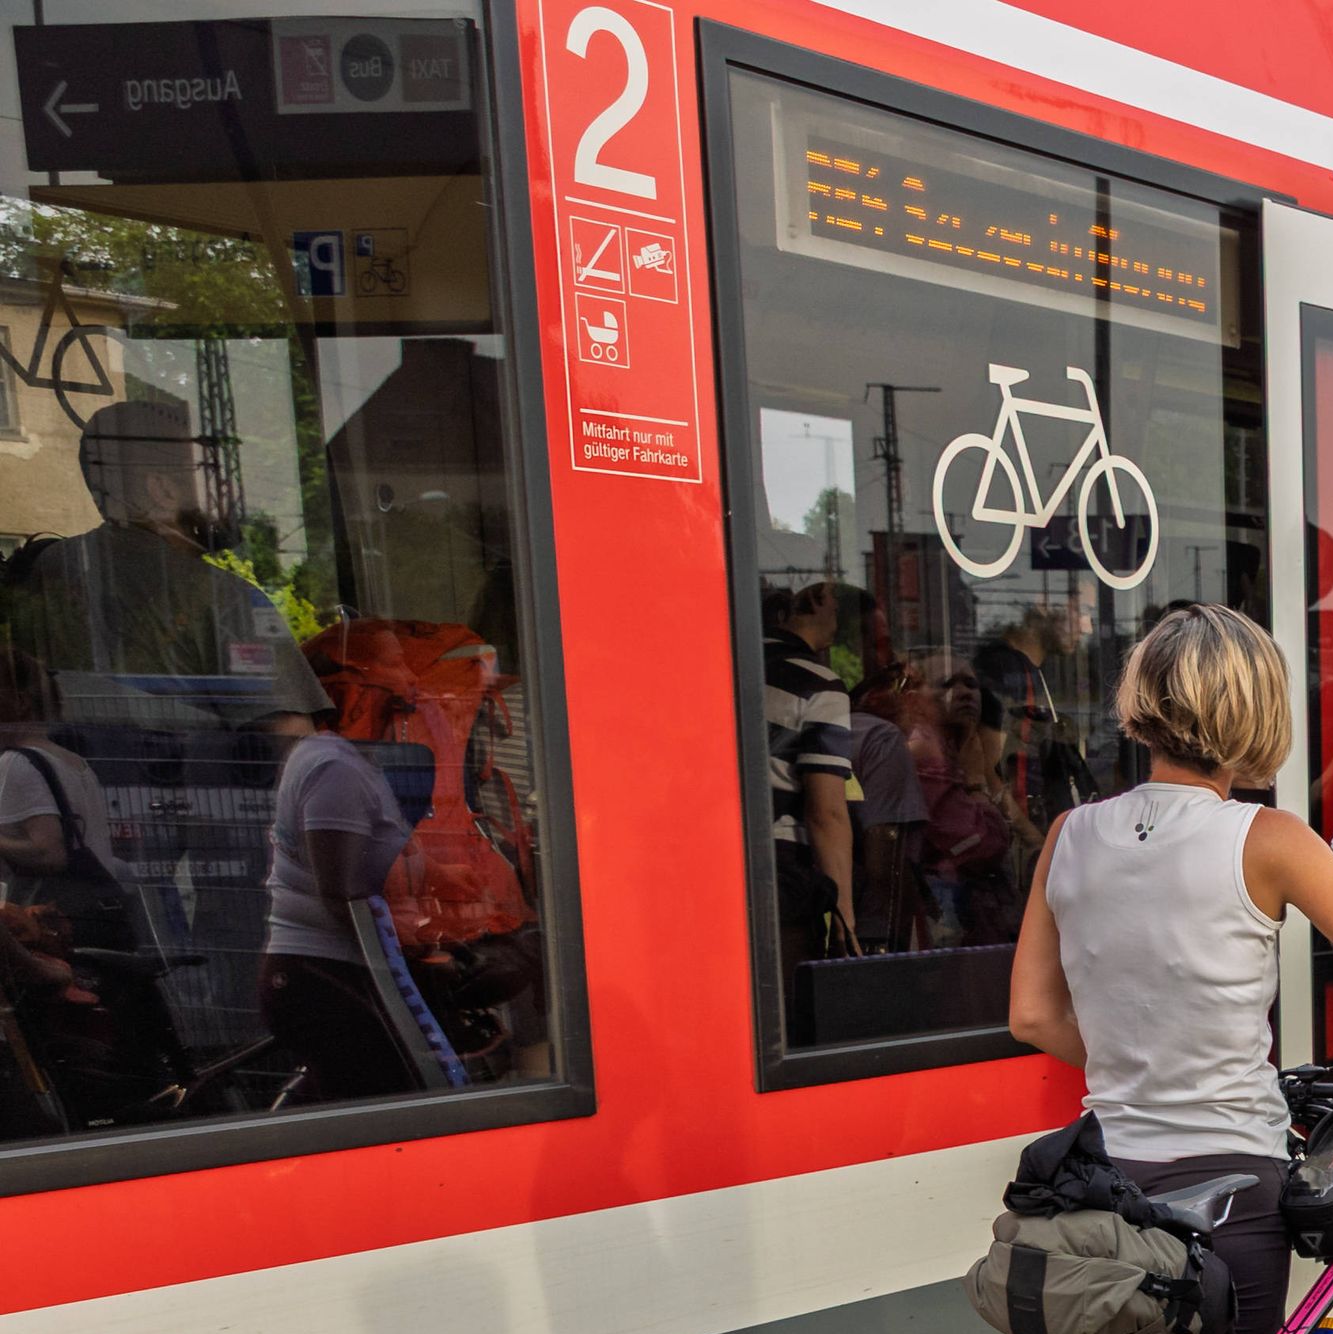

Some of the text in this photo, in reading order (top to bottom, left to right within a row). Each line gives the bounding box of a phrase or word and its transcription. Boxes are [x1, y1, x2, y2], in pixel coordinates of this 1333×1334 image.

[566, 6, 658, 201] 2
[582, 420, 675, 448] Mitfahrt nur mit
[583, 441, 689, 468] gültiger Fahrkarte
